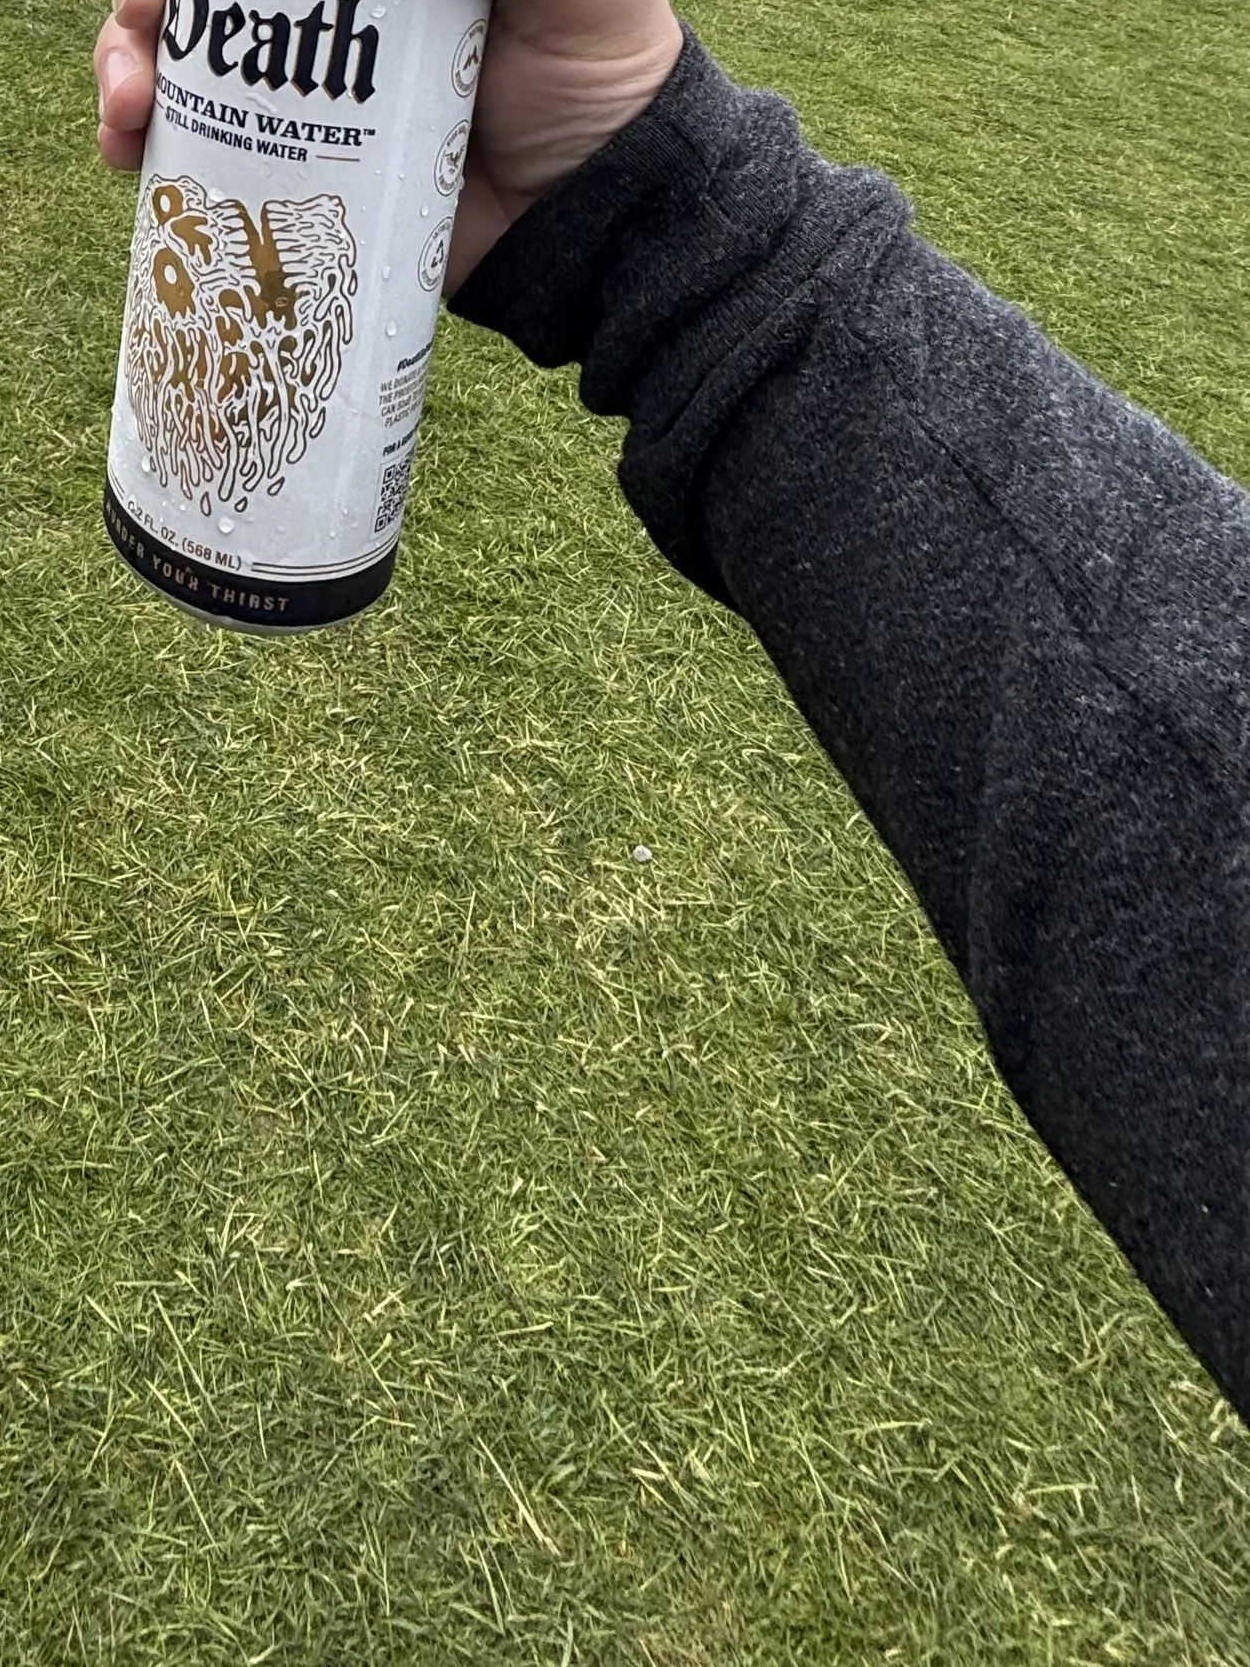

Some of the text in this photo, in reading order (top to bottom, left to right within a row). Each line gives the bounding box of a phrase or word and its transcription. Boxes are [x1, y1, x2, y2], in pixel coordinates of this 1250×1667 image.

[156, 70, 249, 129] MOUNTAIN
[165, 105, 308, 163] STILL DRINKING WATER
[152, 554, 200, 592] YOUR
[207, 581, 290, 612] THIRST
[182, 537, 212, 561] (568
[215, 551, 242, 571] ML)
